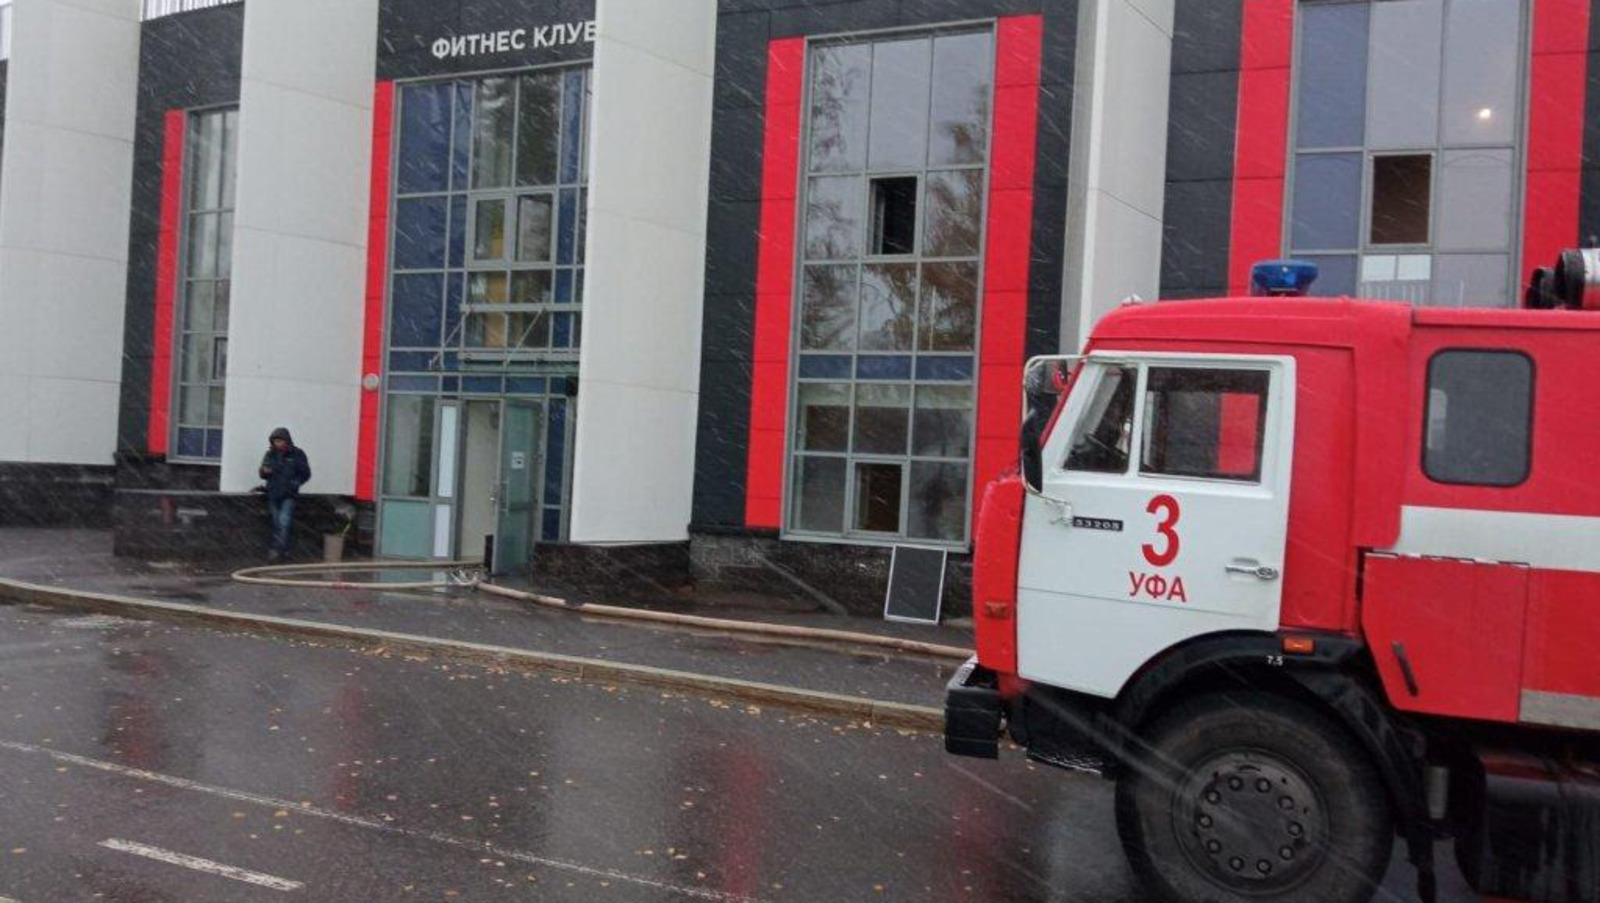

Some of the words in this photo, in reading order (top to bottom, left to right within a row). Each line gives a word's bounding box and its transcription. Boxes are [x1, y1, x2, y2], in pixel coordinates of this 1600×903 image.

[431, 29, 526, 59] ФИТНЕС
[1142, 494, 1180, 567] 3
[1129, 571, 1187, 602] УФА
